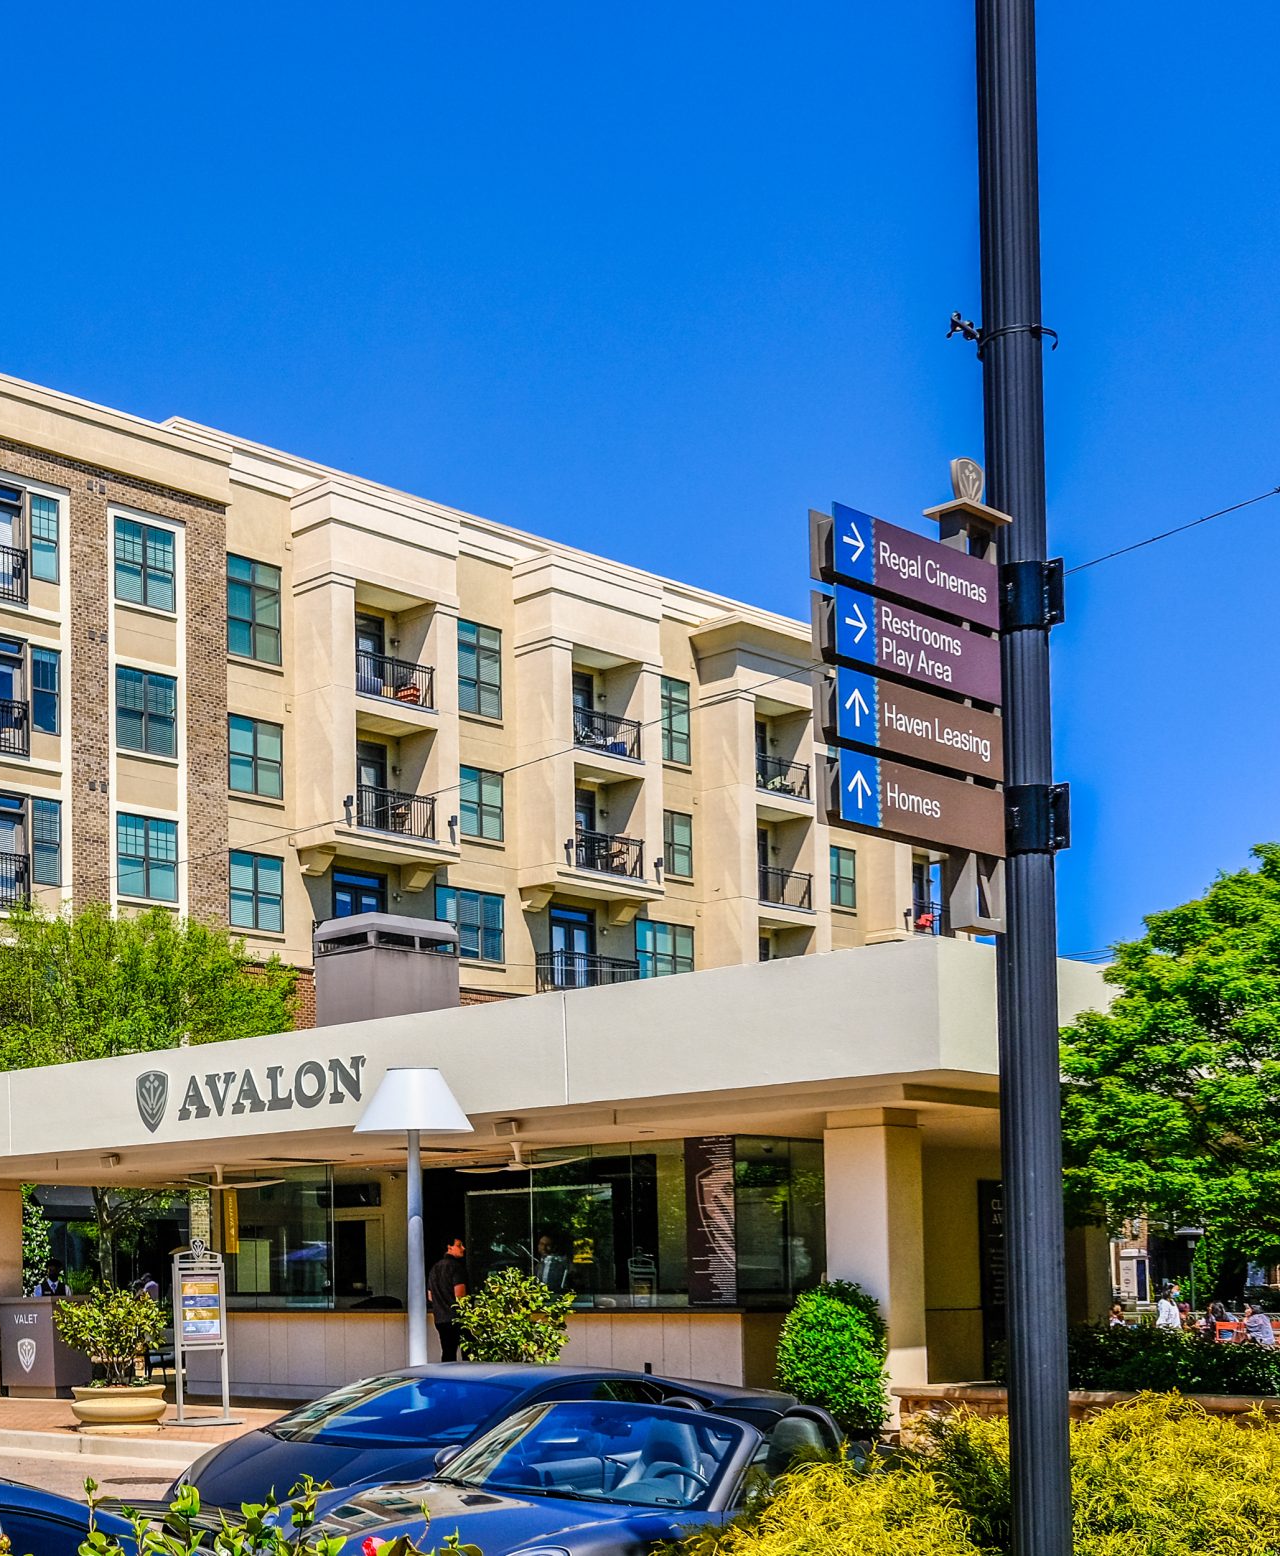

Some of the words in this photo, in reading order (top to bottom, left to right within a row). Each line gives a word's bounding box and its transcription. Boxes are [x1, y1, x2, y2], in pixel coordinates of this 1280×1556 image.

[879, 541, 922, 579] Regal
[925, 560, 987, 603] Cinemas
[881, 606, 962, 656] Restrooms
[882, 637, 915, 674] Play
[917, 650, 952, 682] Area
[884, 702, 932, 740] Haven
[935, 718, 991, 762] Leasing
[886, 782, 941, 818] Homes
[178, 1055, 366, 1121] AVALON
[13, 1313, 38, 1325] VALET
